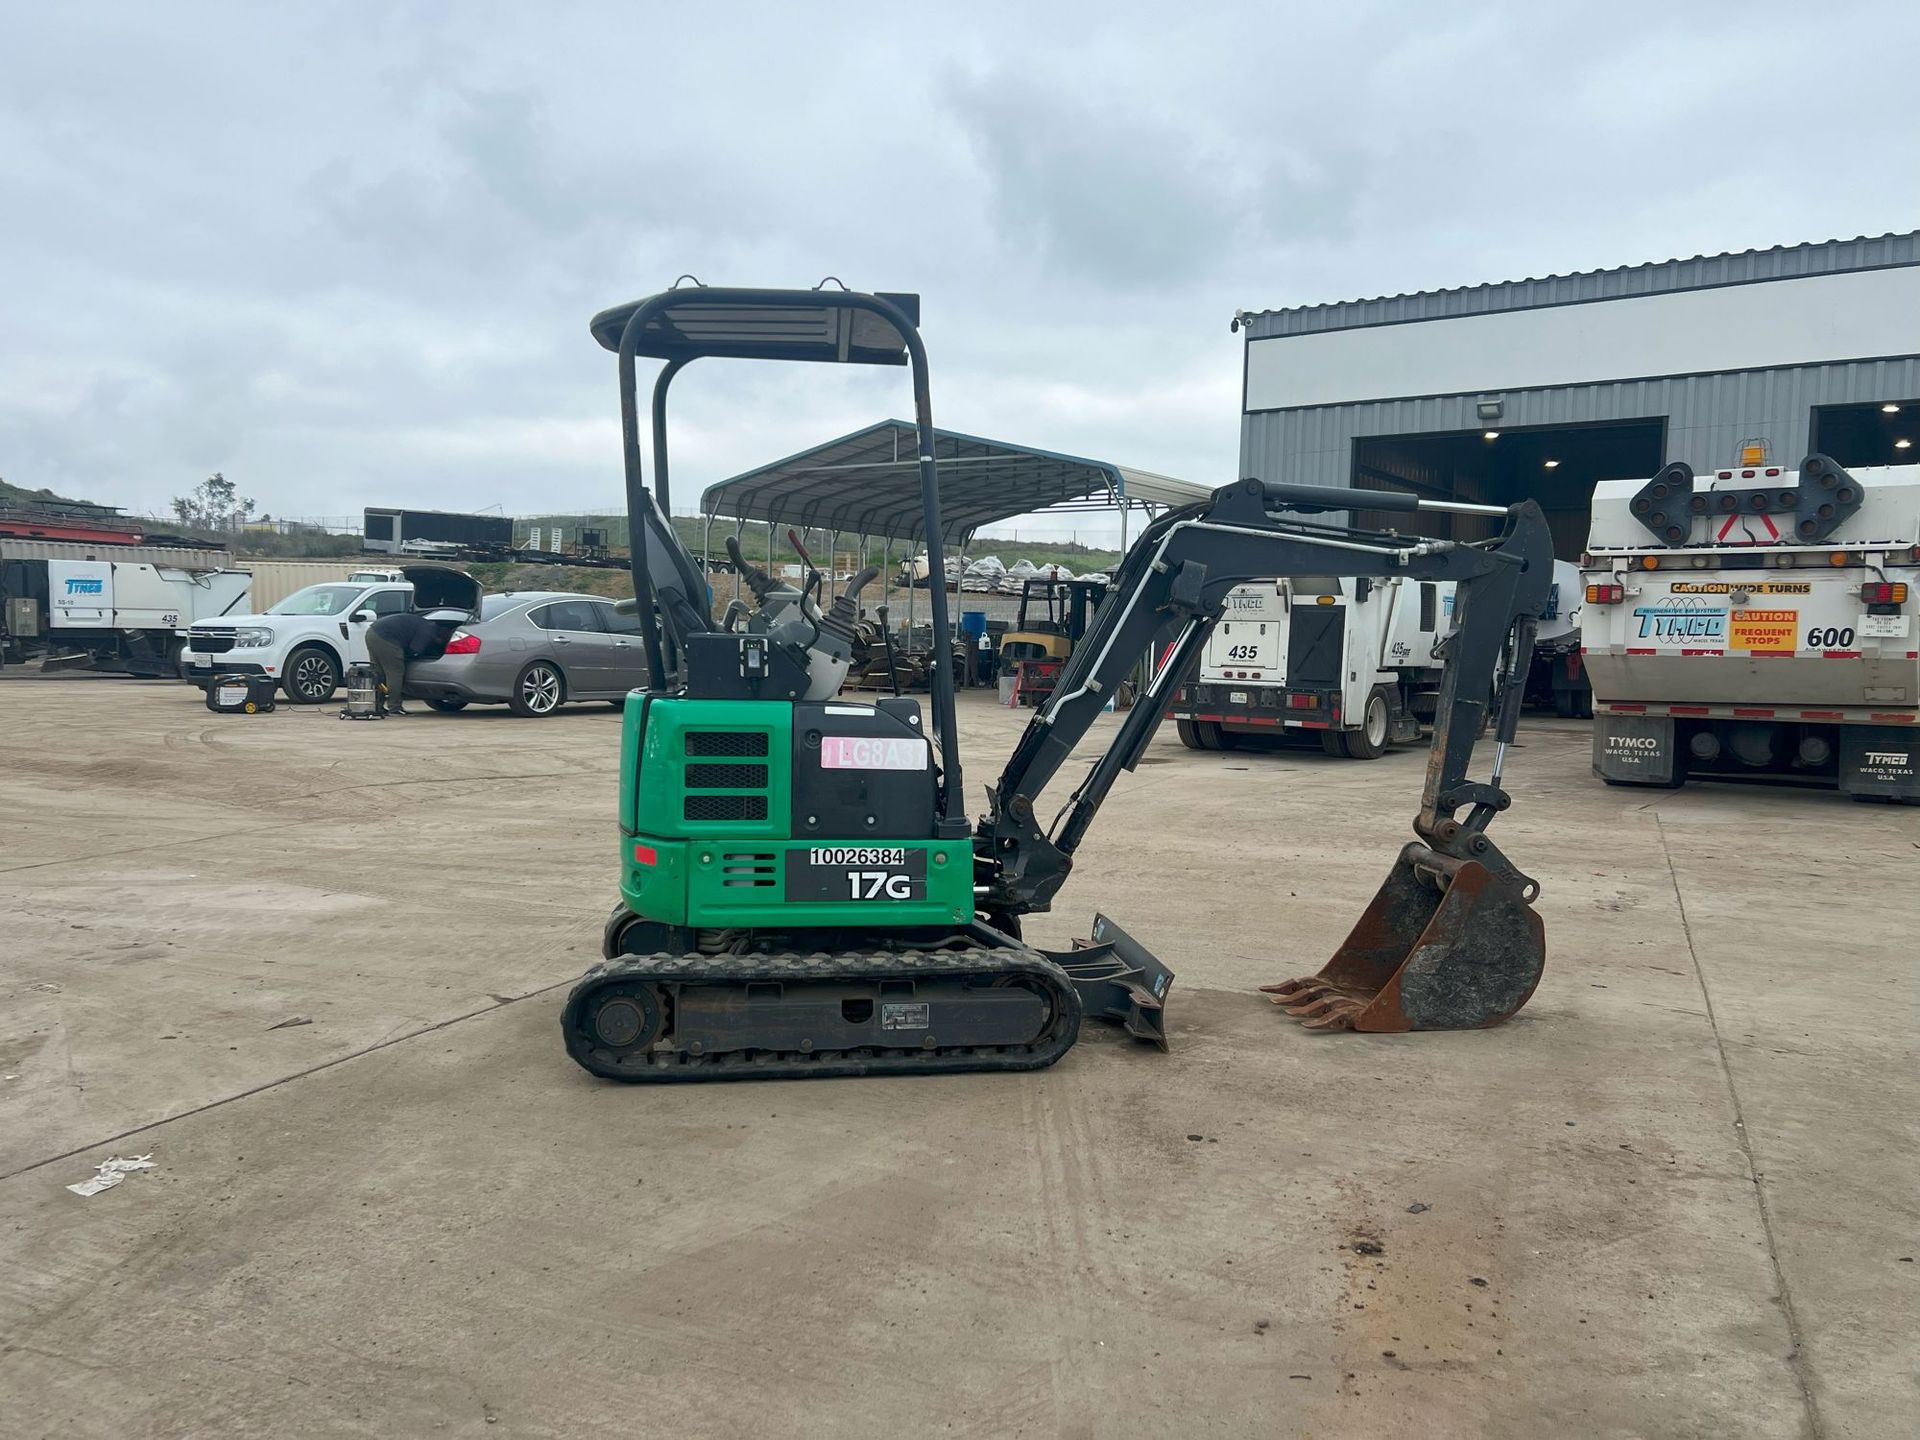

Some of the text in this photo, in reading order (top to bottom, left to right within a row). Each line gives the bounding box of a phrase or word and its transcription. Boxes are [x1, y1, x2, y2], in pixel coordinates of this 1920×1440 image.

[1672, 584, 1728, 593] CAUTION
[1768, 585, 1810, 593] TURNS
[161, 614, 178, 623] 435
[1633, 608, 1729, 638] TYMCO
[1735, 612, 1794, 621] CAUTION
[1745, 637, 1780, 645] STOPS
[1807, 627, 1855, 648] 600
[1228, 645, 1258, 659] 435
[1608, 736, 1657, 749] TYMCO
[1865, 752, 1909, 765] TYMCO
[811, 849, 904, 864] 10026384
[847, 871, 911, 900] 17G
